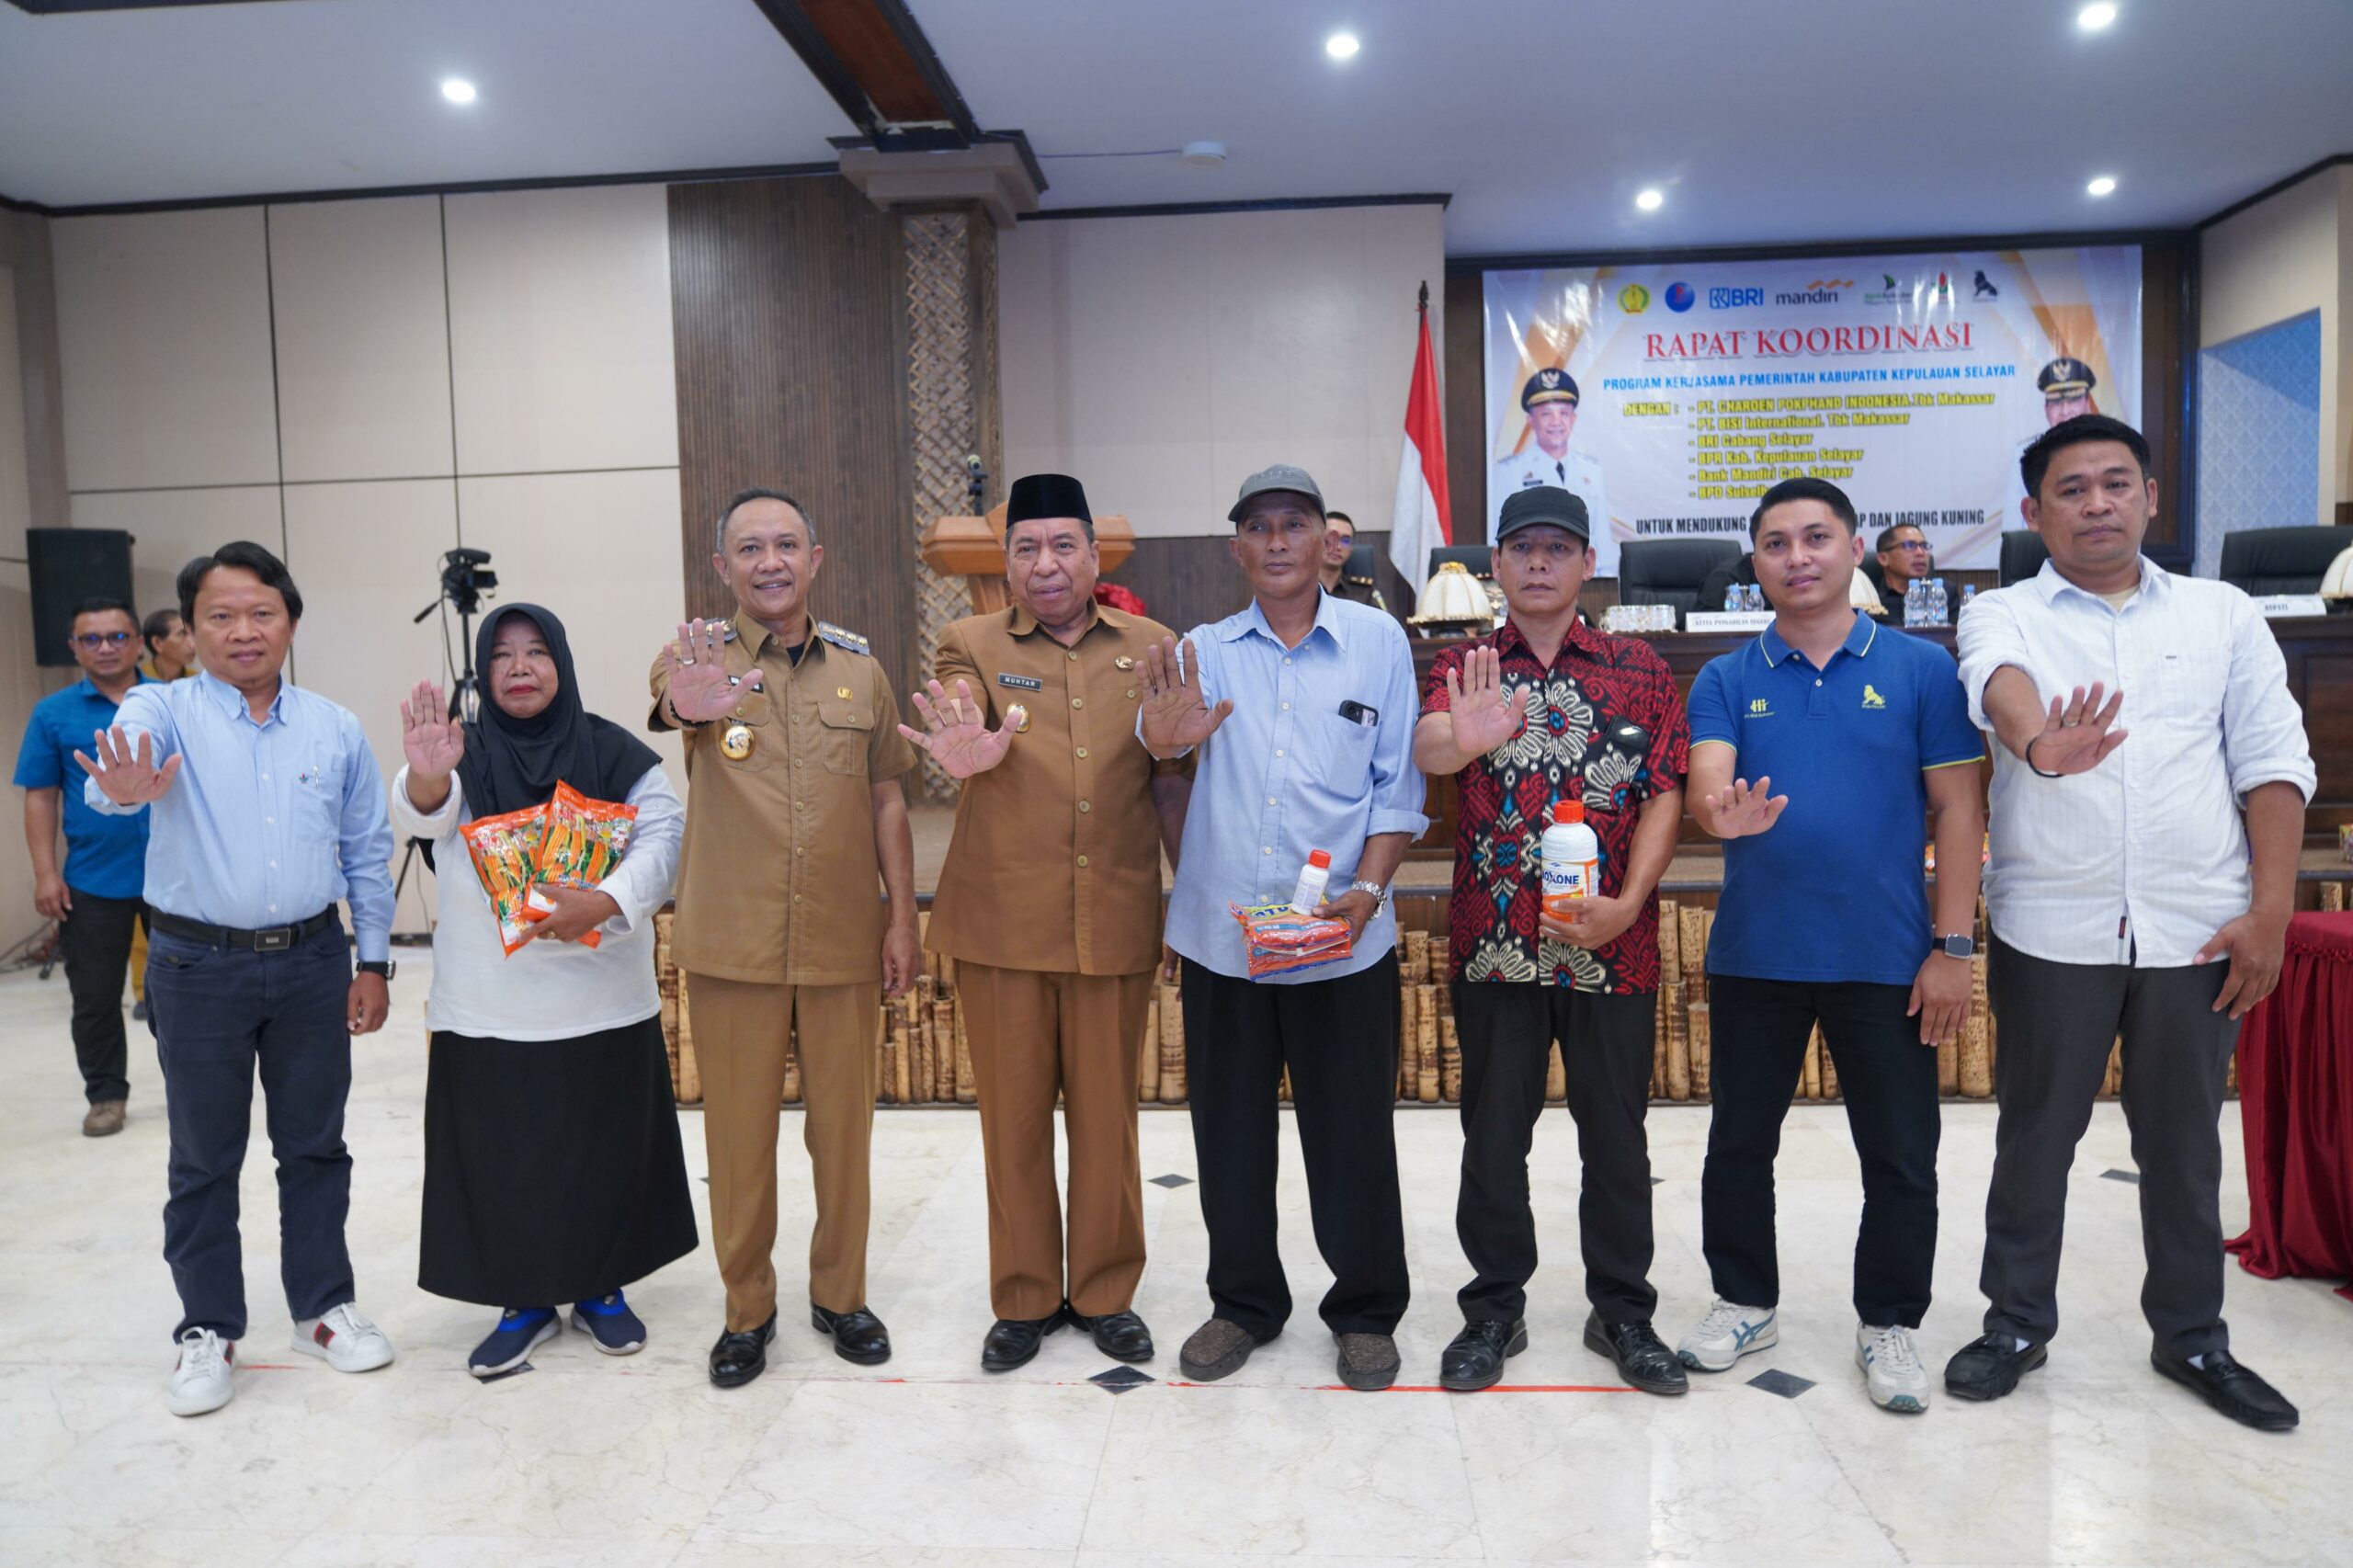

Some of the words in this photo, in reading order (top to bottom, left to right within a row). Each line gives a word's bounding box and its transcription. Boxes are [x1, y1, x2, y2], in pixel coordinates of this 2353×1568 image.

[1776, 289, 1838, 305] mandiri
[1643, 331, 1746, 360] RAPAT
[1754, 322, 1974, 358] KOORDINASI
[1603, 378, 1661, 390] PROGRAM
[1665, 375, 1734, 389] KERJASAMA
[1740, 371, 1815, 386] PEMERINTAH
[1820, 369, 1887, 383] KABUPATEN
[1892, 366, 1960, 381] KEPULAUAN
[1964, 364, 2015, 378] SELAYAR
[1623, 403, 1671, 416] DENGAN
[1698, 401, 1715, 413] PT.
[1718, 398, 1775, 413] CHAROEN
[1778, 396, 1842, 412] POKPHAND
[1938, 392, 1995, 406] Makassar
[1698, 417, 1716, 430] PT.
[1718, 416, 1743, 430] BISI
[1827, 414, 1848, 427] Tbk
[1852, 413, 1910, 426] Makassar
[1698, 435, 1719, 448] BRI
[1722, 433, 1766, 449] Cabang
[1769, 432, 1813, 447] Selayar
[1698, 451, 1723, 465] BPR
[1754, 449, 1816, 465] Kepulauan
[1819, 448, 1864, 463] Selayar
[1698, 469, 1728, 482] Bank
[1731, 467, 1776, 482] Mandiri
[1809, 465, 1853, 480] Selayar
[1636, 519, 1674, 533] UNTUK
[1677, 517, 1746, 533] MENDUKUNG
[1870, 512, 1892, 528] DAN
[1941, 508, 1984, 526] KUNING
[1005, 676, 1036, 687] MUHTAR
[1541, 870, 1580, 885] OXONE
